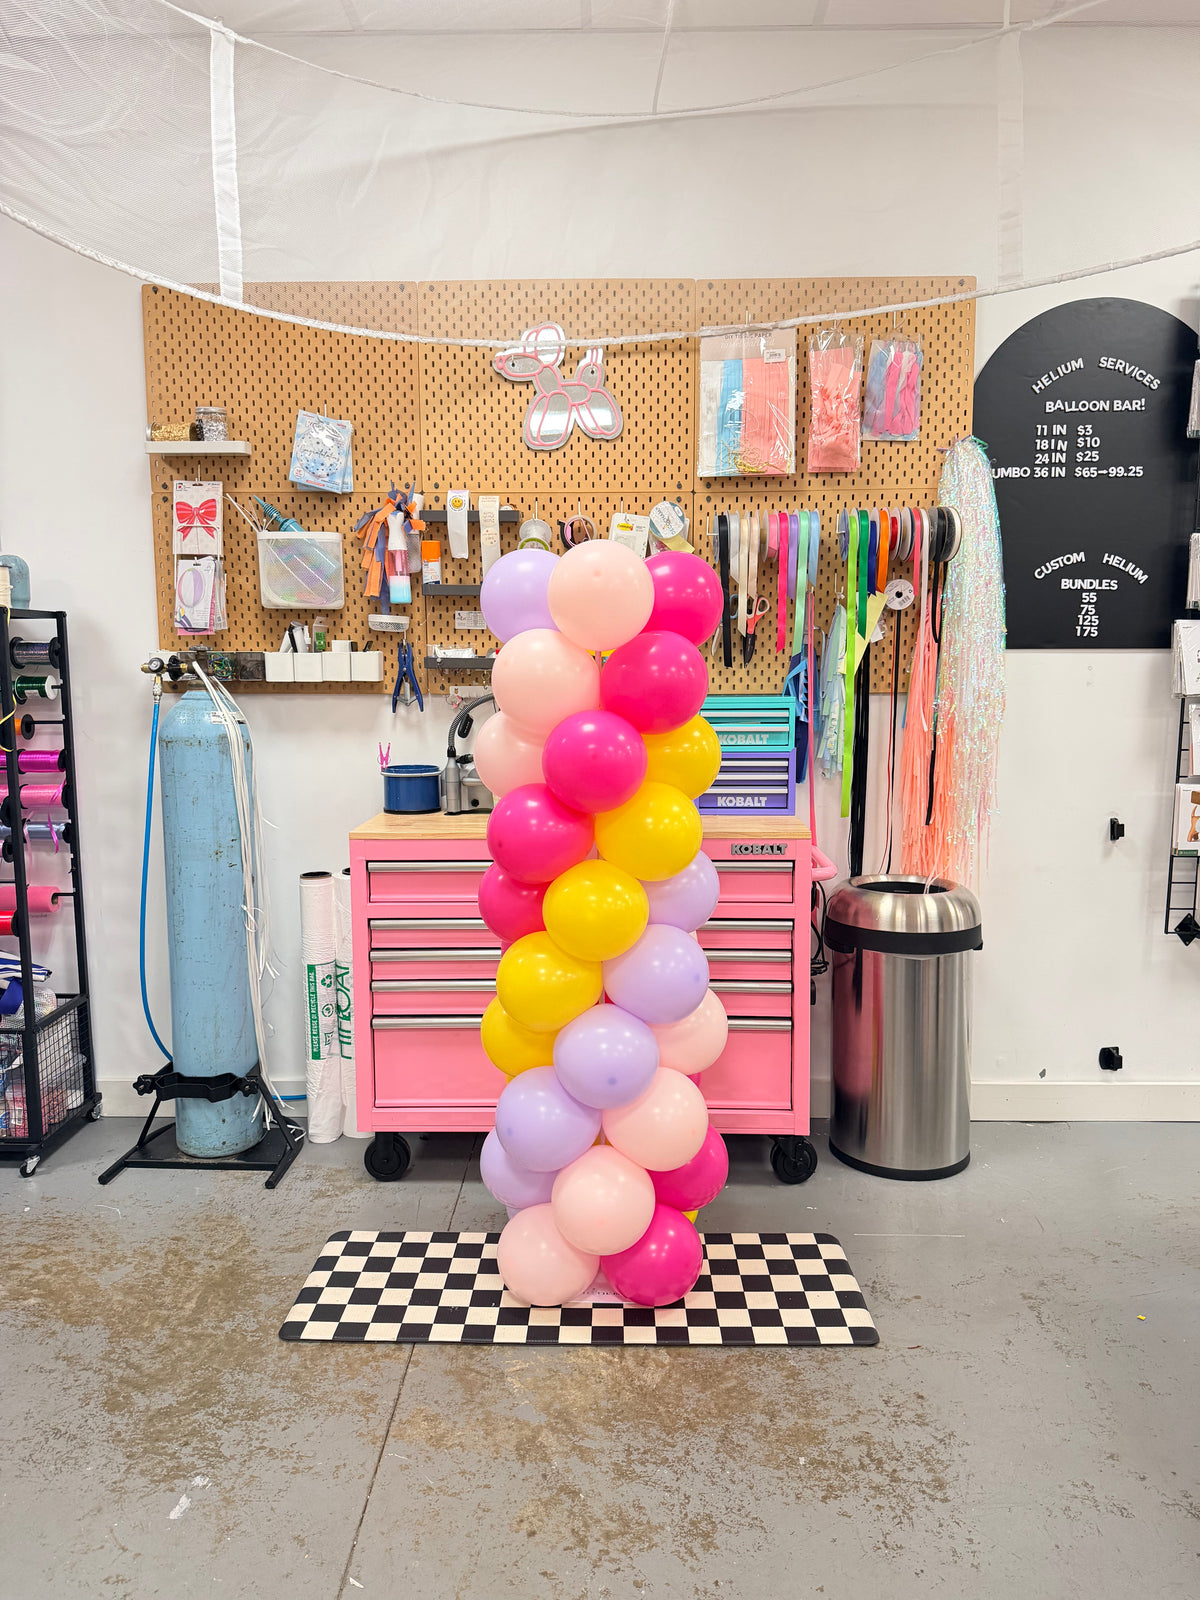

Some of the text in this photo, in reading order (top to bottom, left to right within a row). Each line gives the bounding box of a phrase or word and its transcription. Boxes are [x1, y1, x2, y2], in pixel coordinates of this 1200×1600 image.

[1032, 356, 1161, 394] HELIUM SERVICES
[1045, 398, 1146, 413] BALLOON BAR!
[1036, 424, 1093, 436] 11 IN $3
[1035, 436, 1101, 452] 18 IN $10
[1035, 450, 1100, 465] 24 IN $25
[992, 466, 1031, 479] UMBO
[1033, 466, 1049, 478] 36
[1051, 466, 1066, 478] IN
[1034, 552, 1149, 585] CUSTOM HELIUM
[1060, 578, 1118, 591] BUNDLES
[1081, 592, 1098, 603] 55
[1080, 604, 1096, 616] 75
[1077, 614, 1100, 626] 125
[1075, 626, 1099, 638] 175
[719, 734, 769, 745] KOBALT
[717, 796, 768, 807] KOBALT
[731, 843, 788, 856] KOBALT
